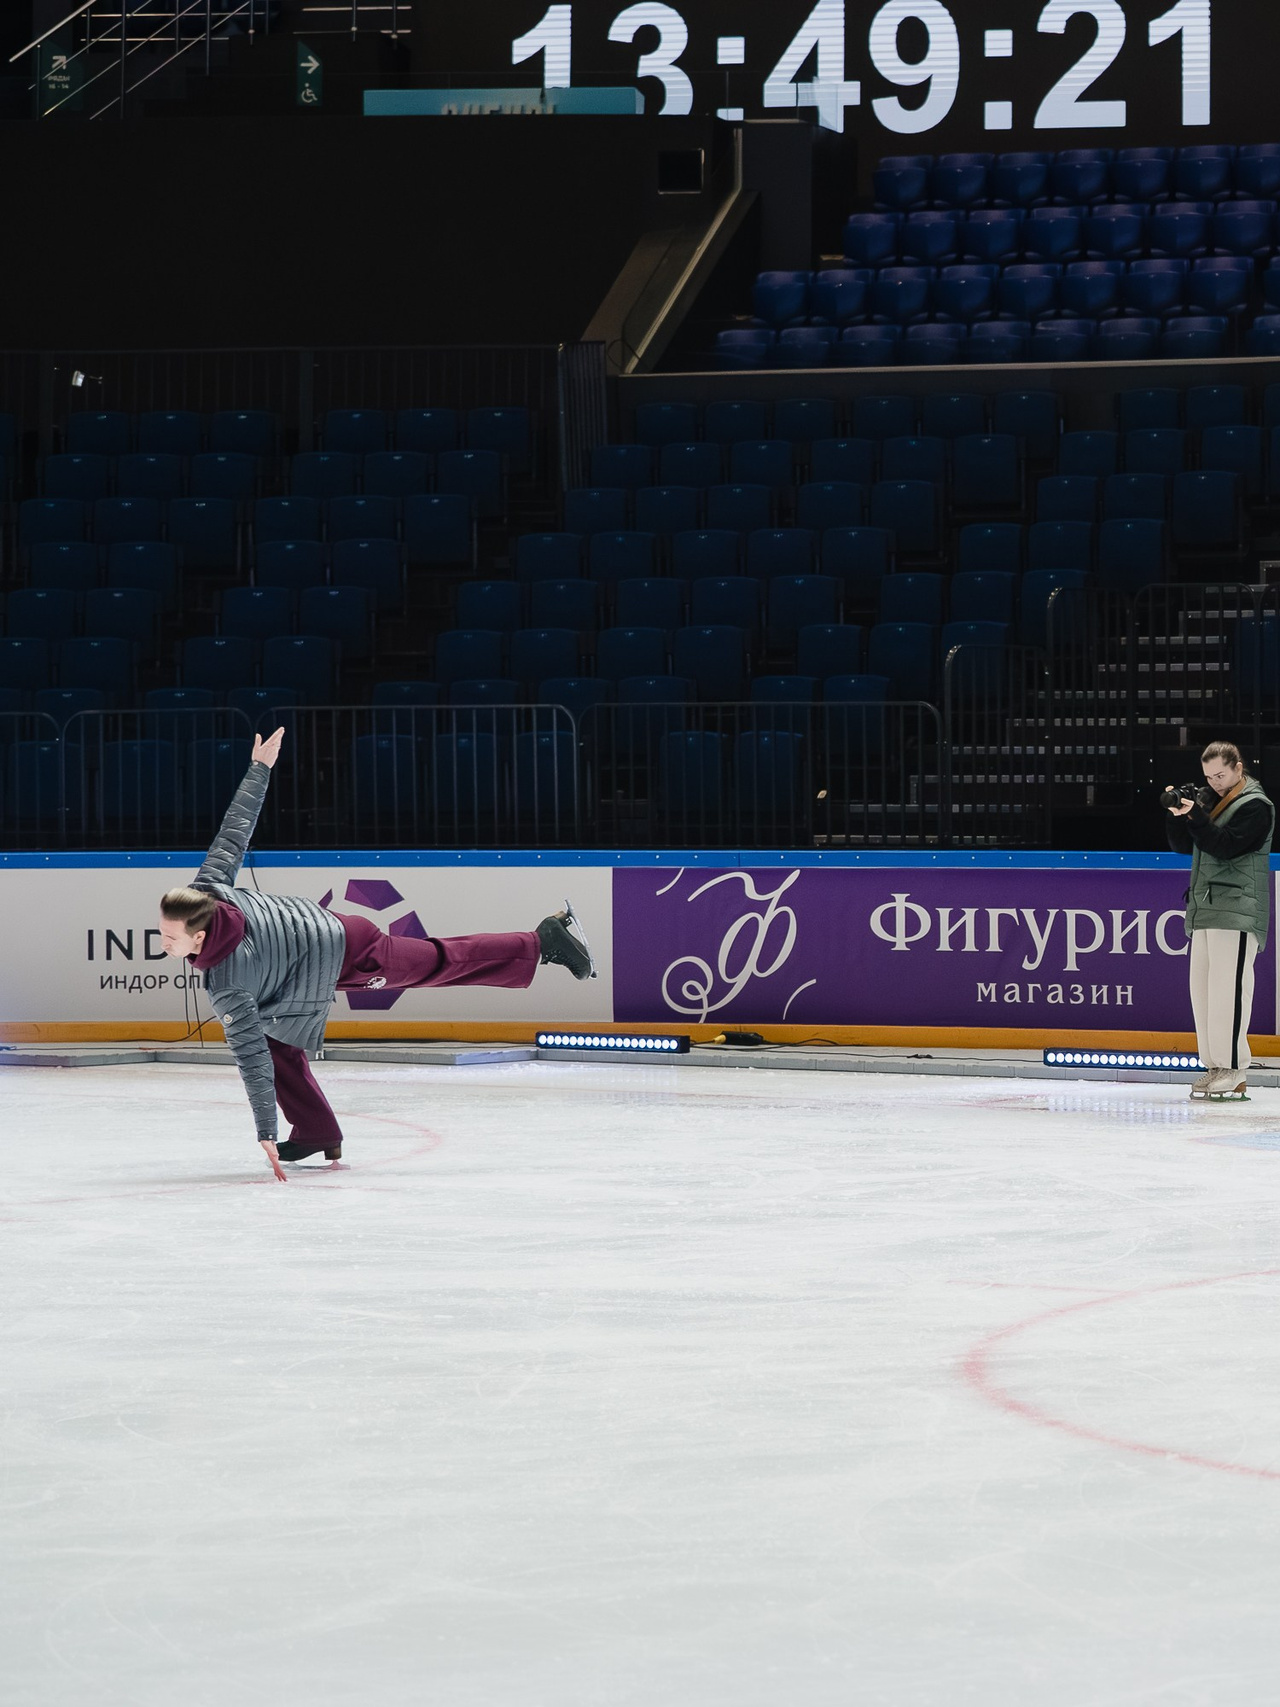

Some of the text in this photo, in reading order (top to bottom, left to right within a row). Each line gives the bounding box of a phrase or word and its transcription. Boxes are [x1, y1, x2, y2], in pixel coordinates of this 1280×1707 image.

[512, 0, 1210, 133] 13:49:21
[869, 892, 1190, 972] Фигурис
[100, 975, 169, 994] ИНДОР
[976, 982, 1134, 1007] магазин
